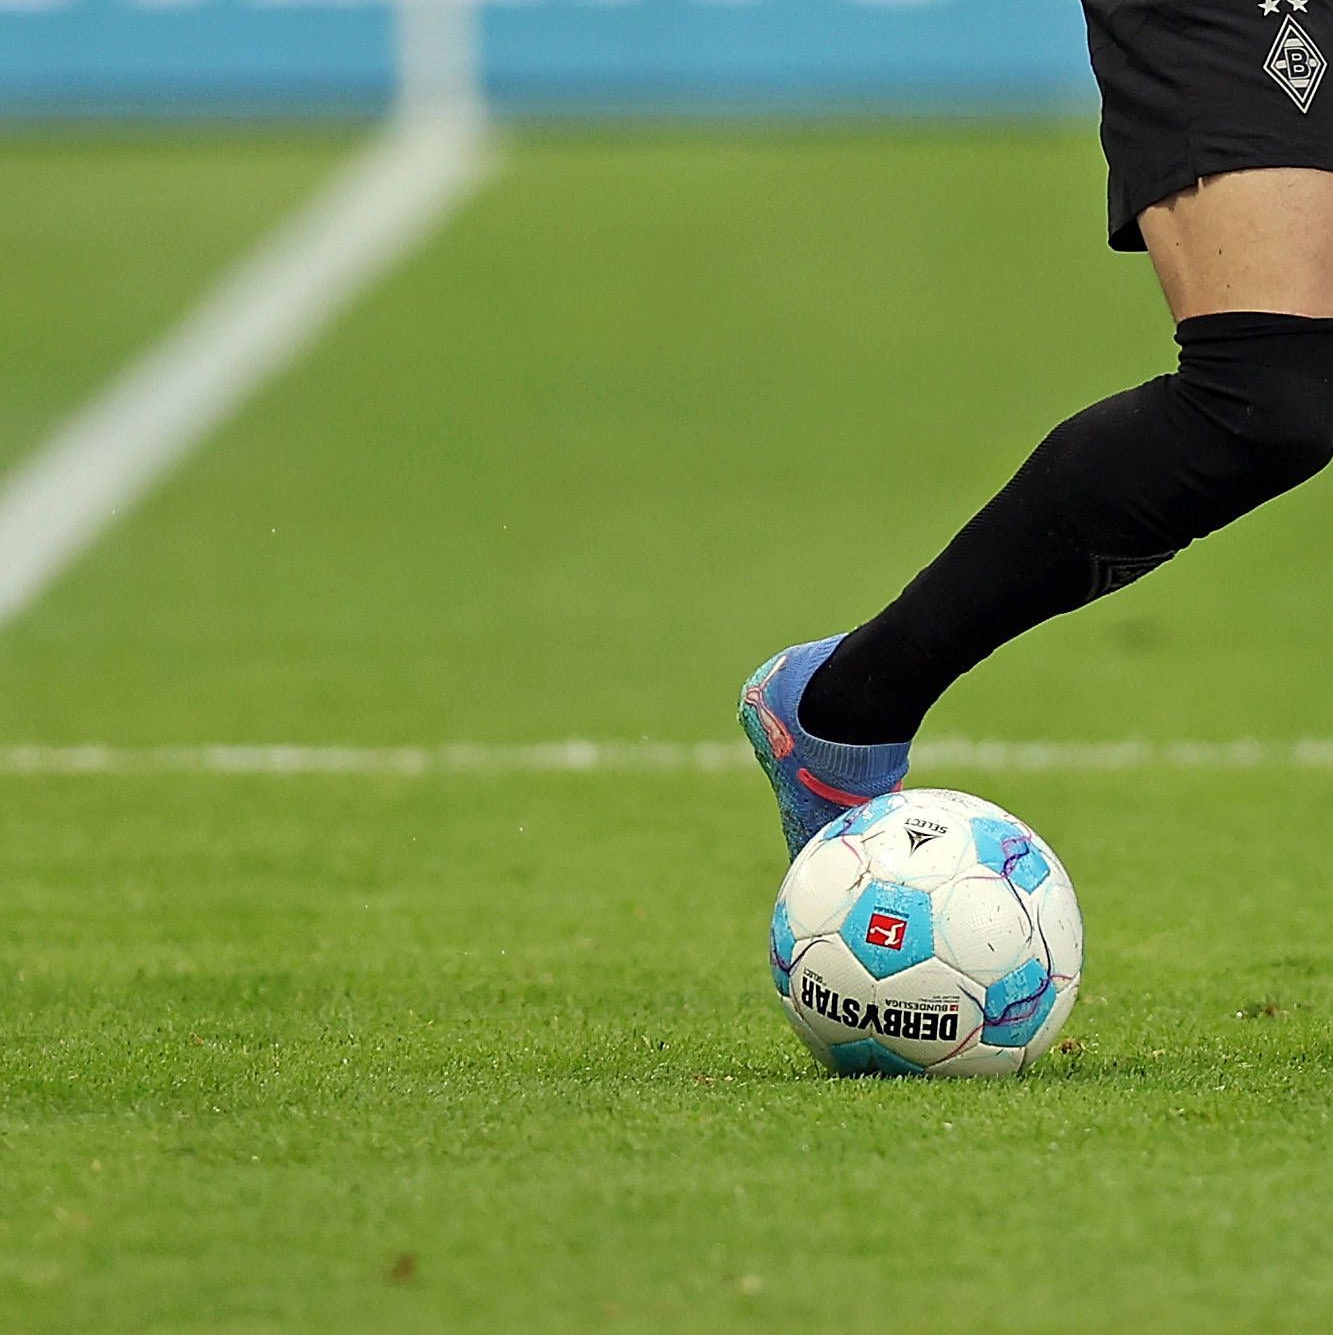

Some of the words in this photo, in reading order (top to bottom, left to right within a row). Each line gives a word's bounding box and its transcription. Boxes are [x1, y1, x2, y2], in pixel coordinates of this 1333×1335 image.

[904, 817, 949, 834] SELECT
[801, 976, 959, 1041] DERBYSTAR
[885, 998, 948, 1012] BUNDESLIGA
